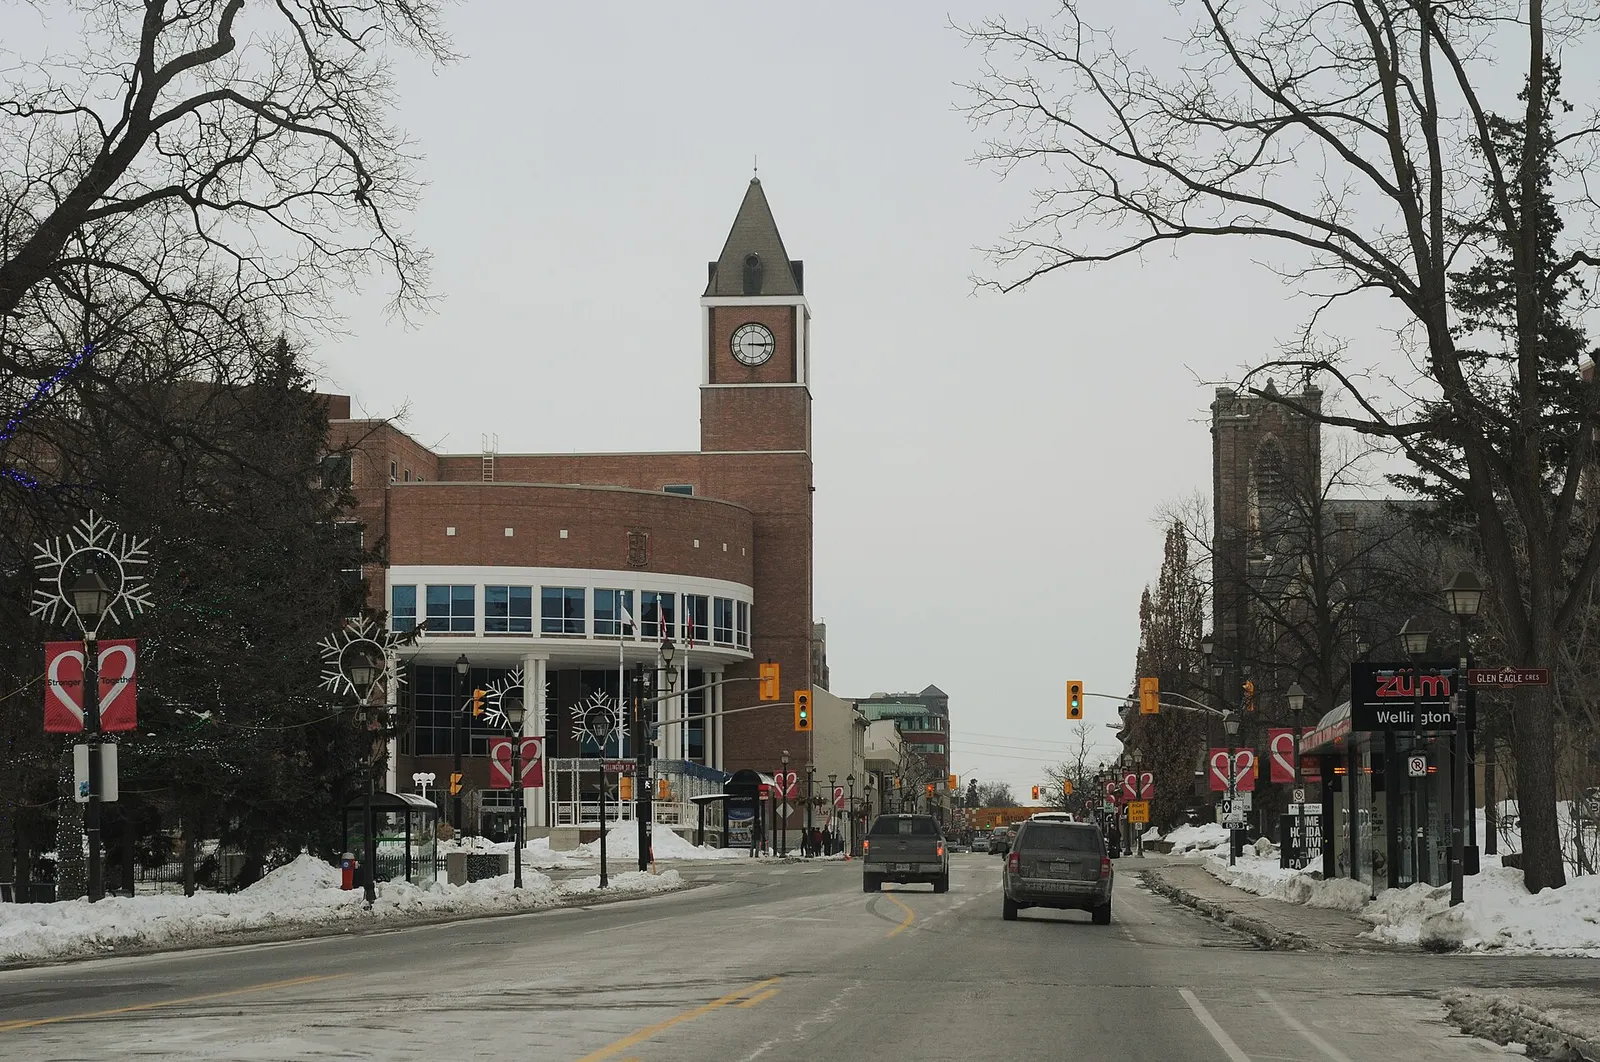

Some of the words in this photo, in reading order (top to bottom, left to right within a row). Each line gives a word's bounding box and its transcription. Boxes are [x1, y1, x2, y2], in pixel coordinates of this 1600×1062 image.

[48, 678, 80, 687] Stronger
[101, 676, 136, 685] Together
[1477, 674, 1497, 683] GLEN
[1499, 674, 1522, 683] EAGLE
[1525, 674, 1540, 682] CRES
[1294, 816, 1319, 827] HME
[1290, 827, 1323, 837] HOIDA
[1292, 837, 1323, 848] ATIVI
